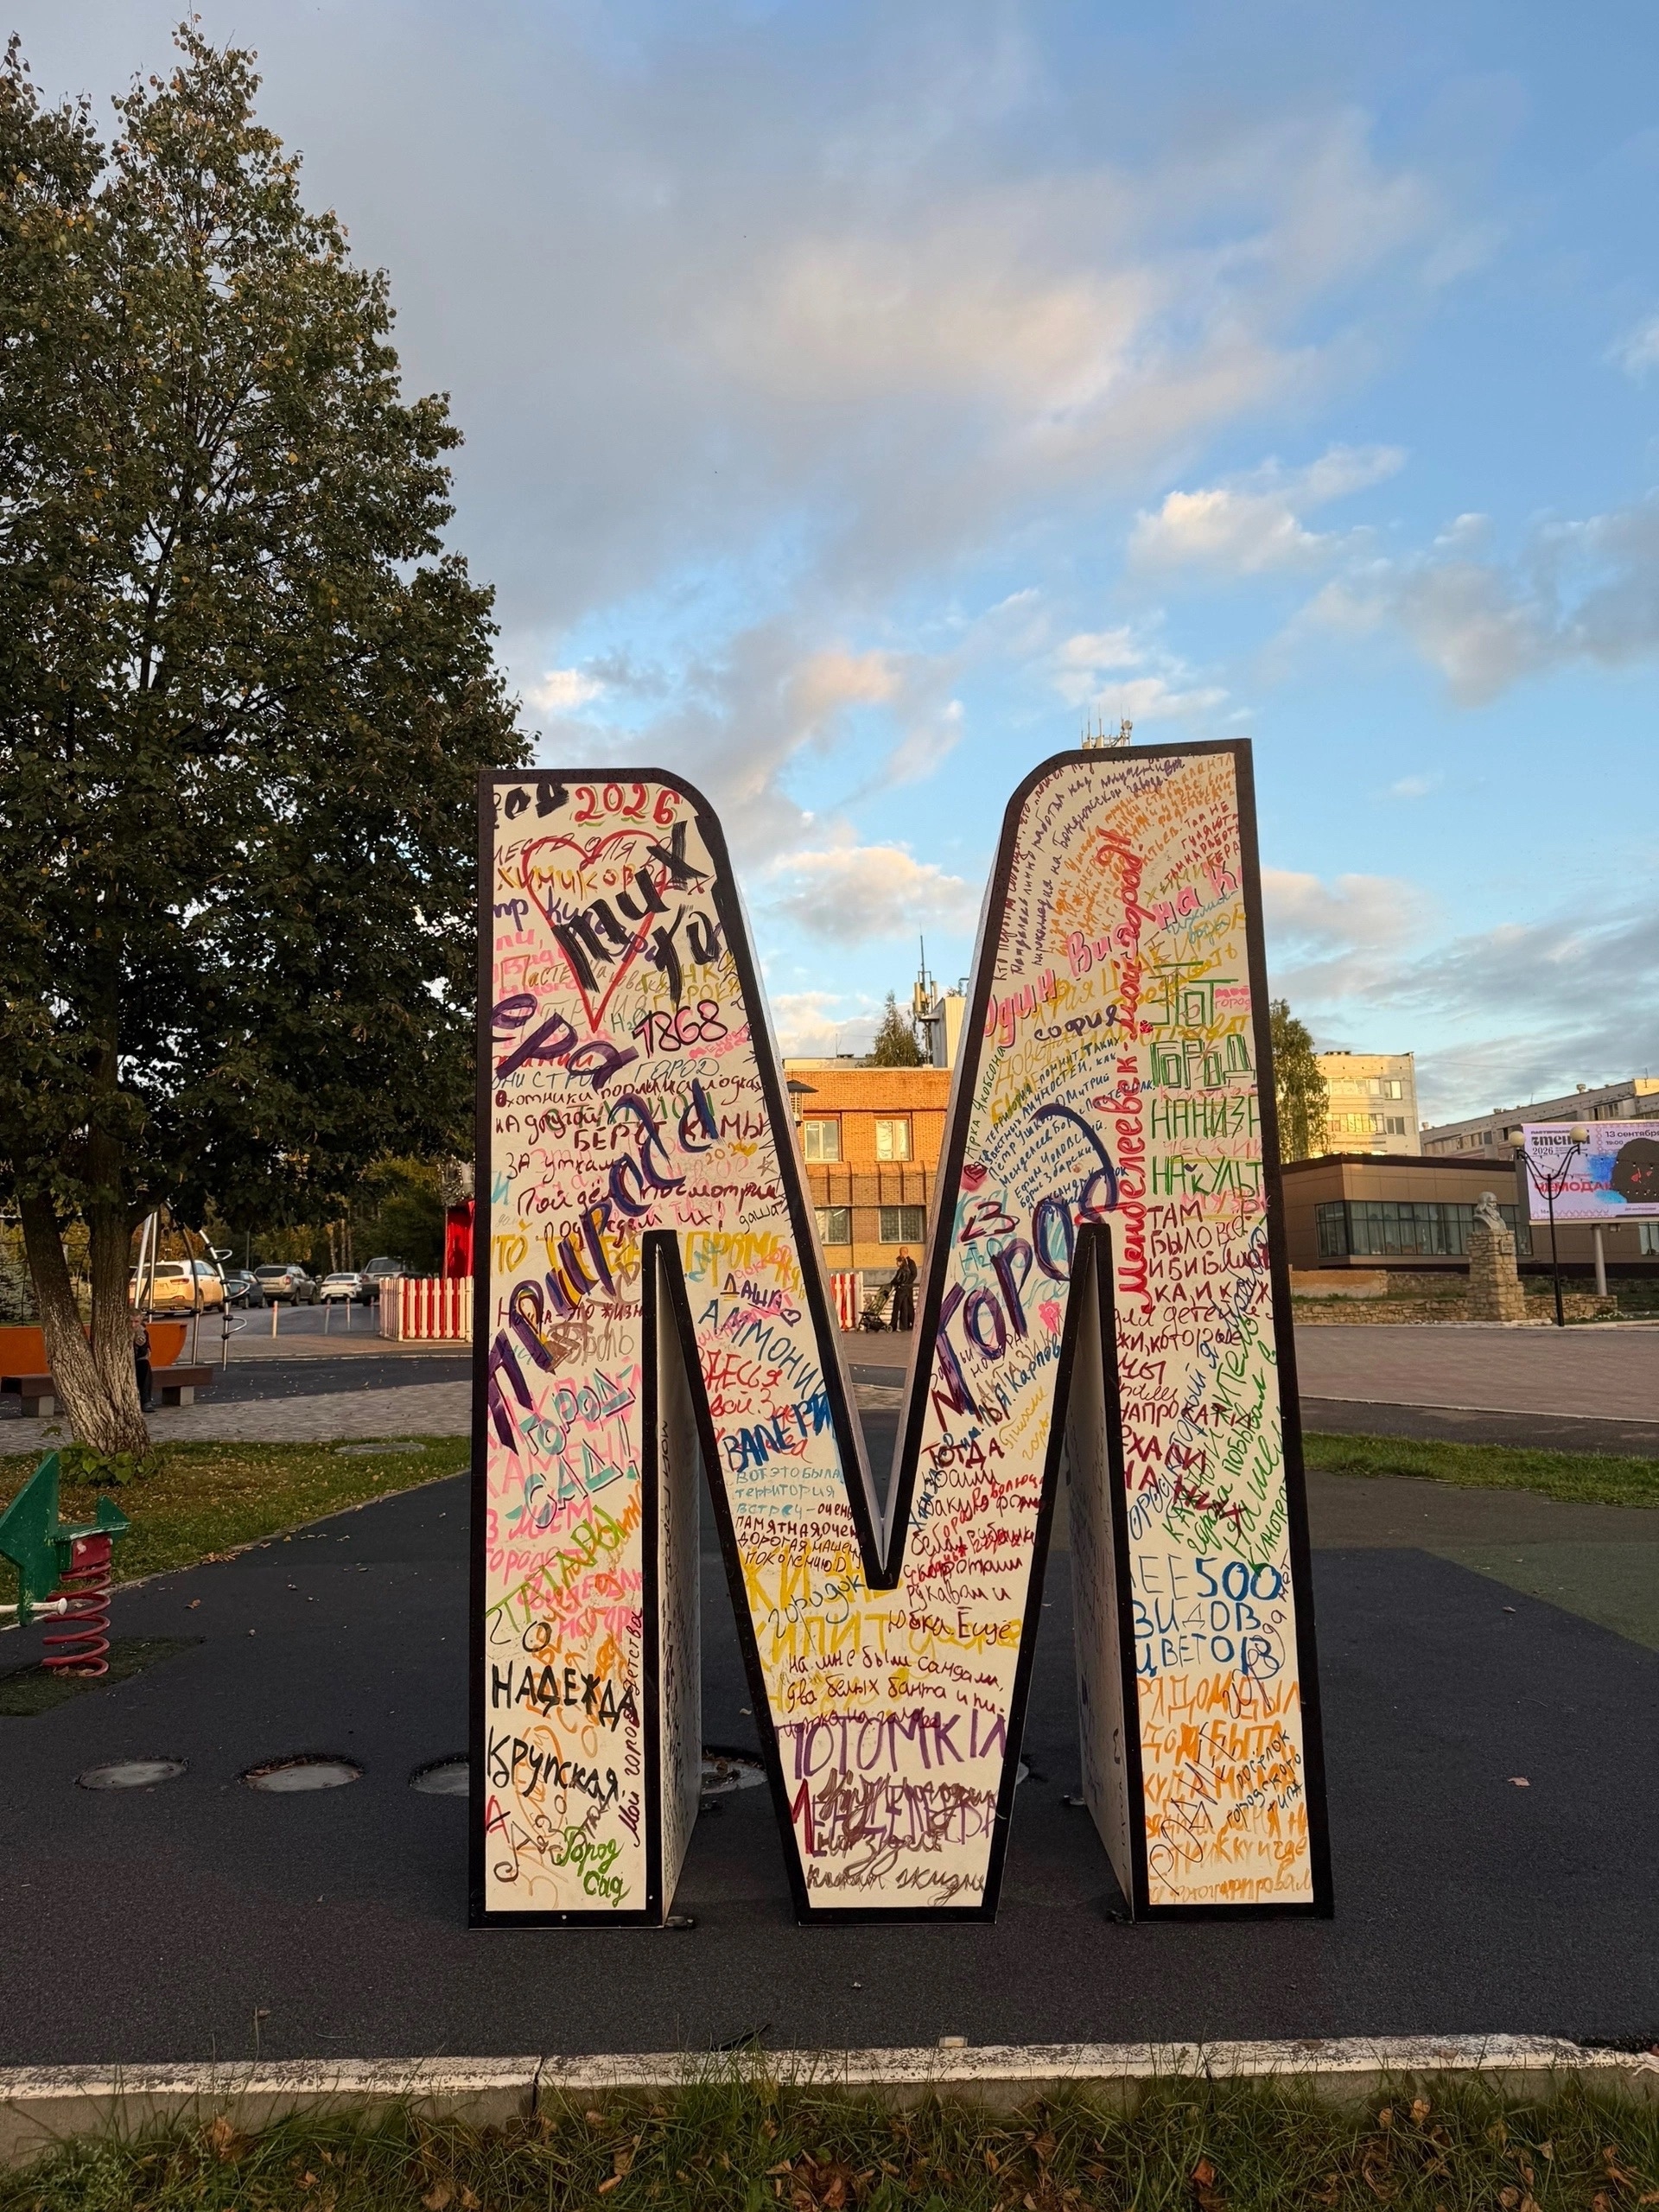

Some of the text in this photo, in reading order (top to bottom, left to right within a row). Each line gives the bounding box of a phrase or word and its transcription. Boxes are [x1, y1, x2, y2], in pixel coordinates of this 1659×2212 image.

[575, 782, 680, 825] 2026
[632, 999, 728, 1058] 1868
[1196, 1557, 1282, 1601] 500
[1133, 1598, 1262, 1639] ВИДОВ
